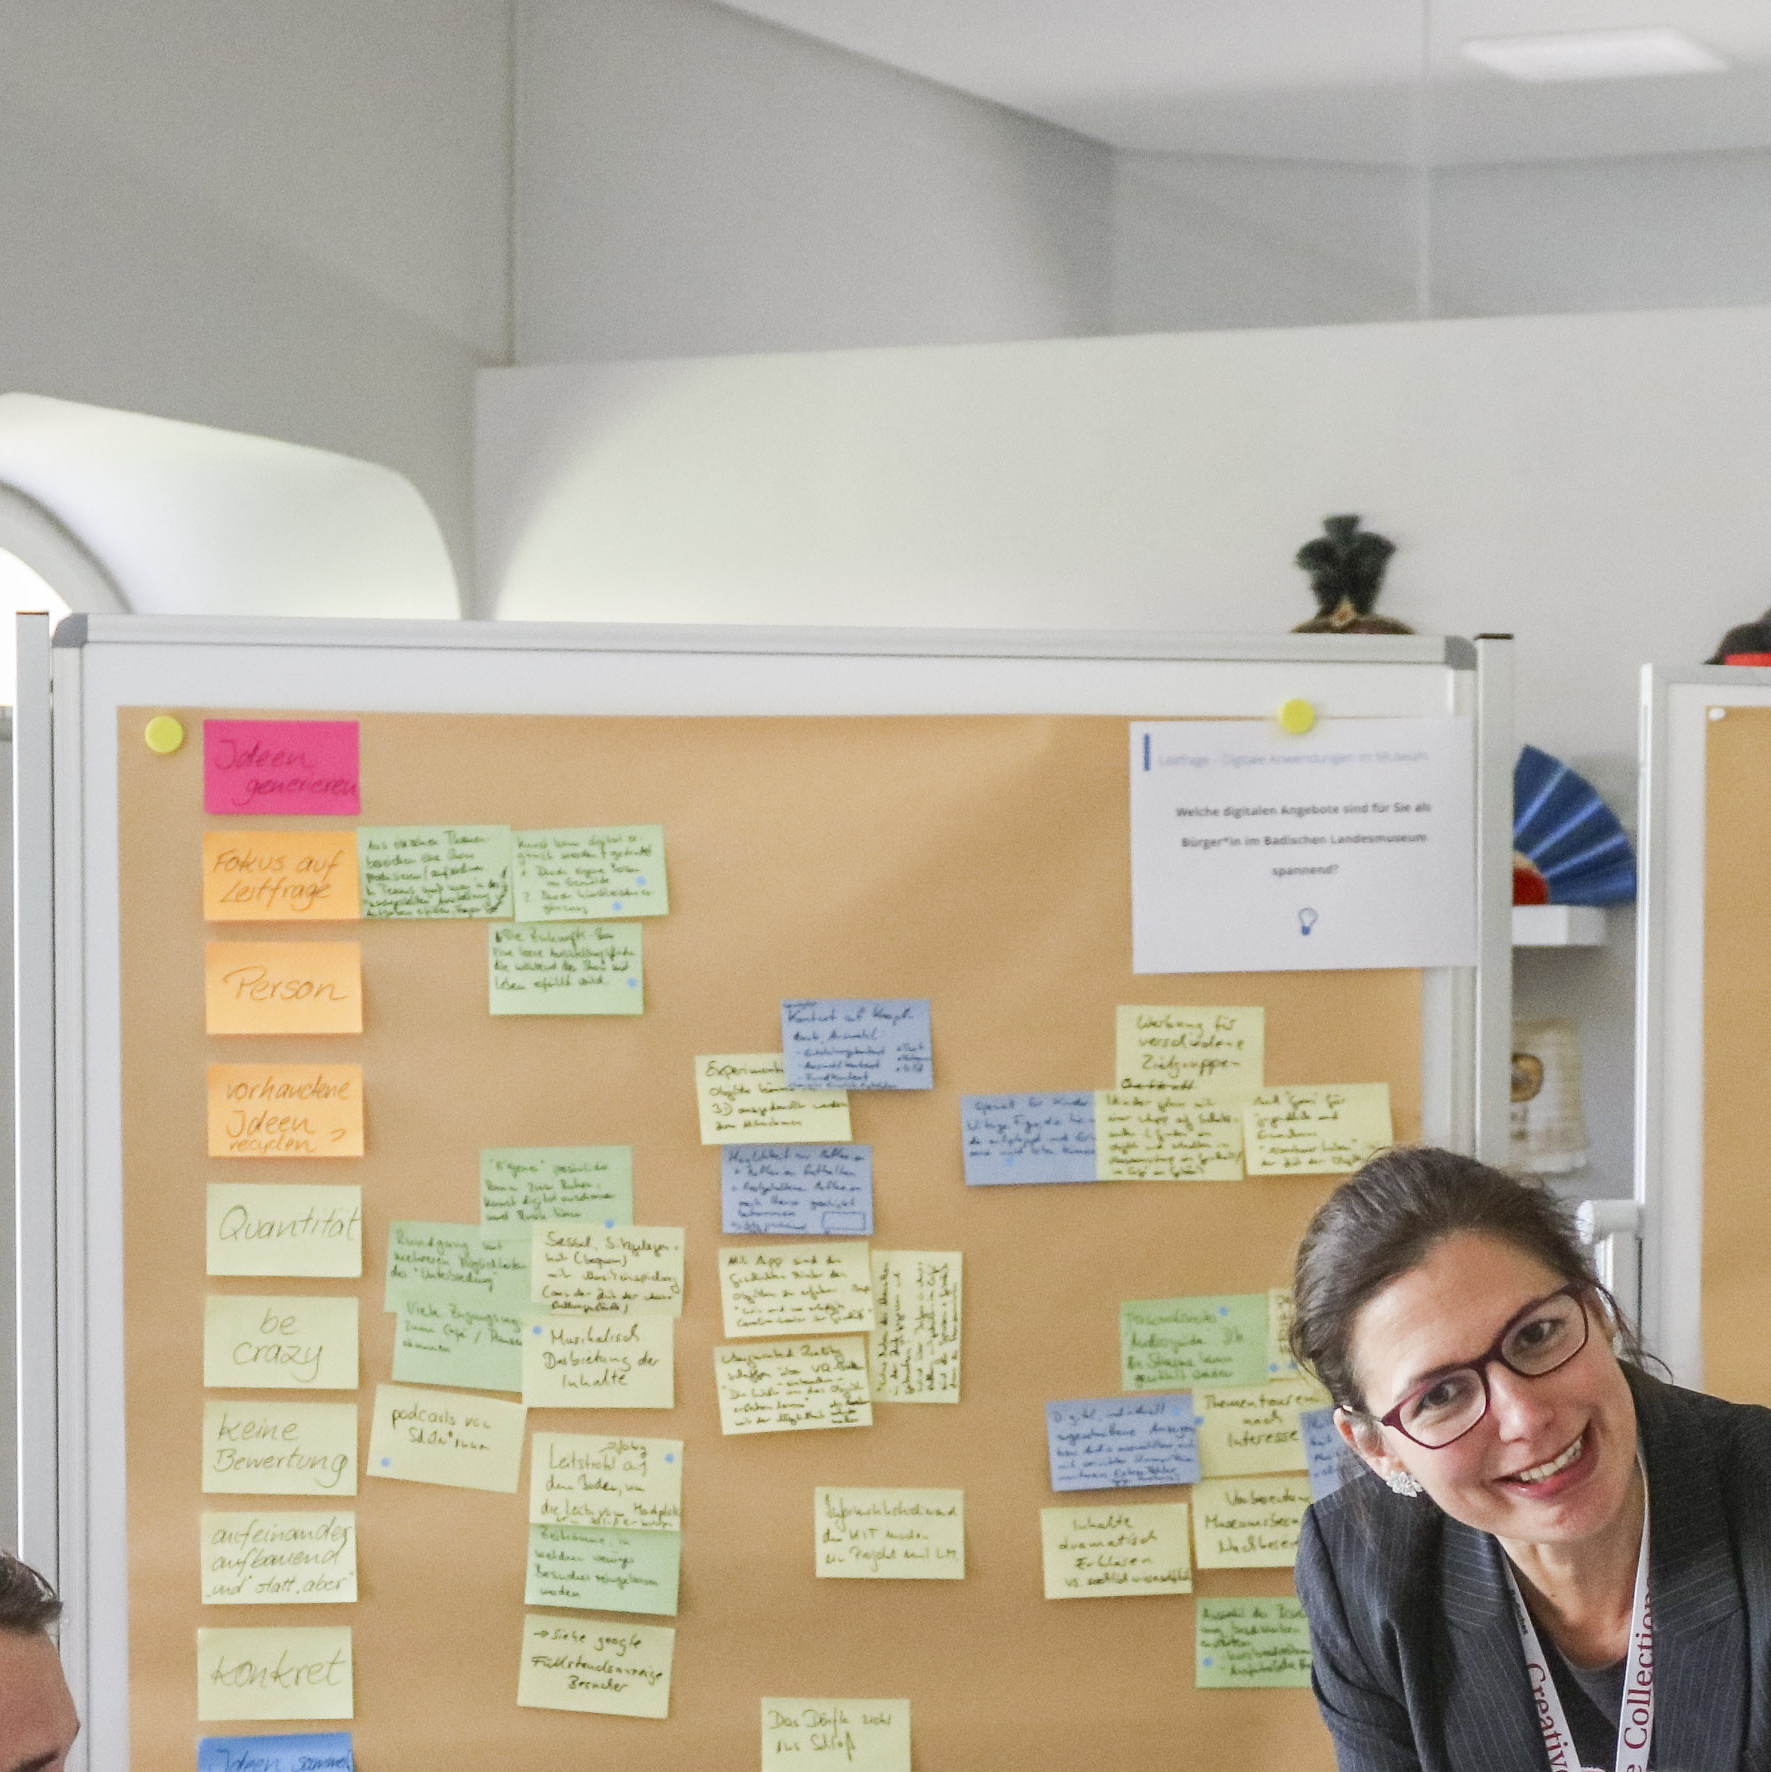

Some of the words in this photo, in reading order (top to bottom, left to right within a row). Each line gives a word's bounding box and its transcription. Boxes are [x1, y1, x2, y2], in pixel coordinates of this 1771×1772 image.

[1175, 804, 1221, 818] Welche
[1222, 803, 1278, 821] digitalen
[1281, 802, 1340, 820] Angebote
[1342, 801, 1370, 815] sind
[1371, 801, 1391, 814] für
[1393, 801, 1412, 814] Sie
[1414, 801, 1433, 813] als
[1243, 834, 1261, 847] im
[1263, 833, 1328, 847] Badischen
[1330, 830, 1429, 846] Landesmuseum
[297, 849, 344, 874] auf
[1271, 863, 1340, 879] spannend?
[223, 966, 349, 1002] Person
[259, 1308, 298, 1336] be
[232, 1340, 323, 1383] crazy
[213, 1447, 349, 1489] Bewertung
